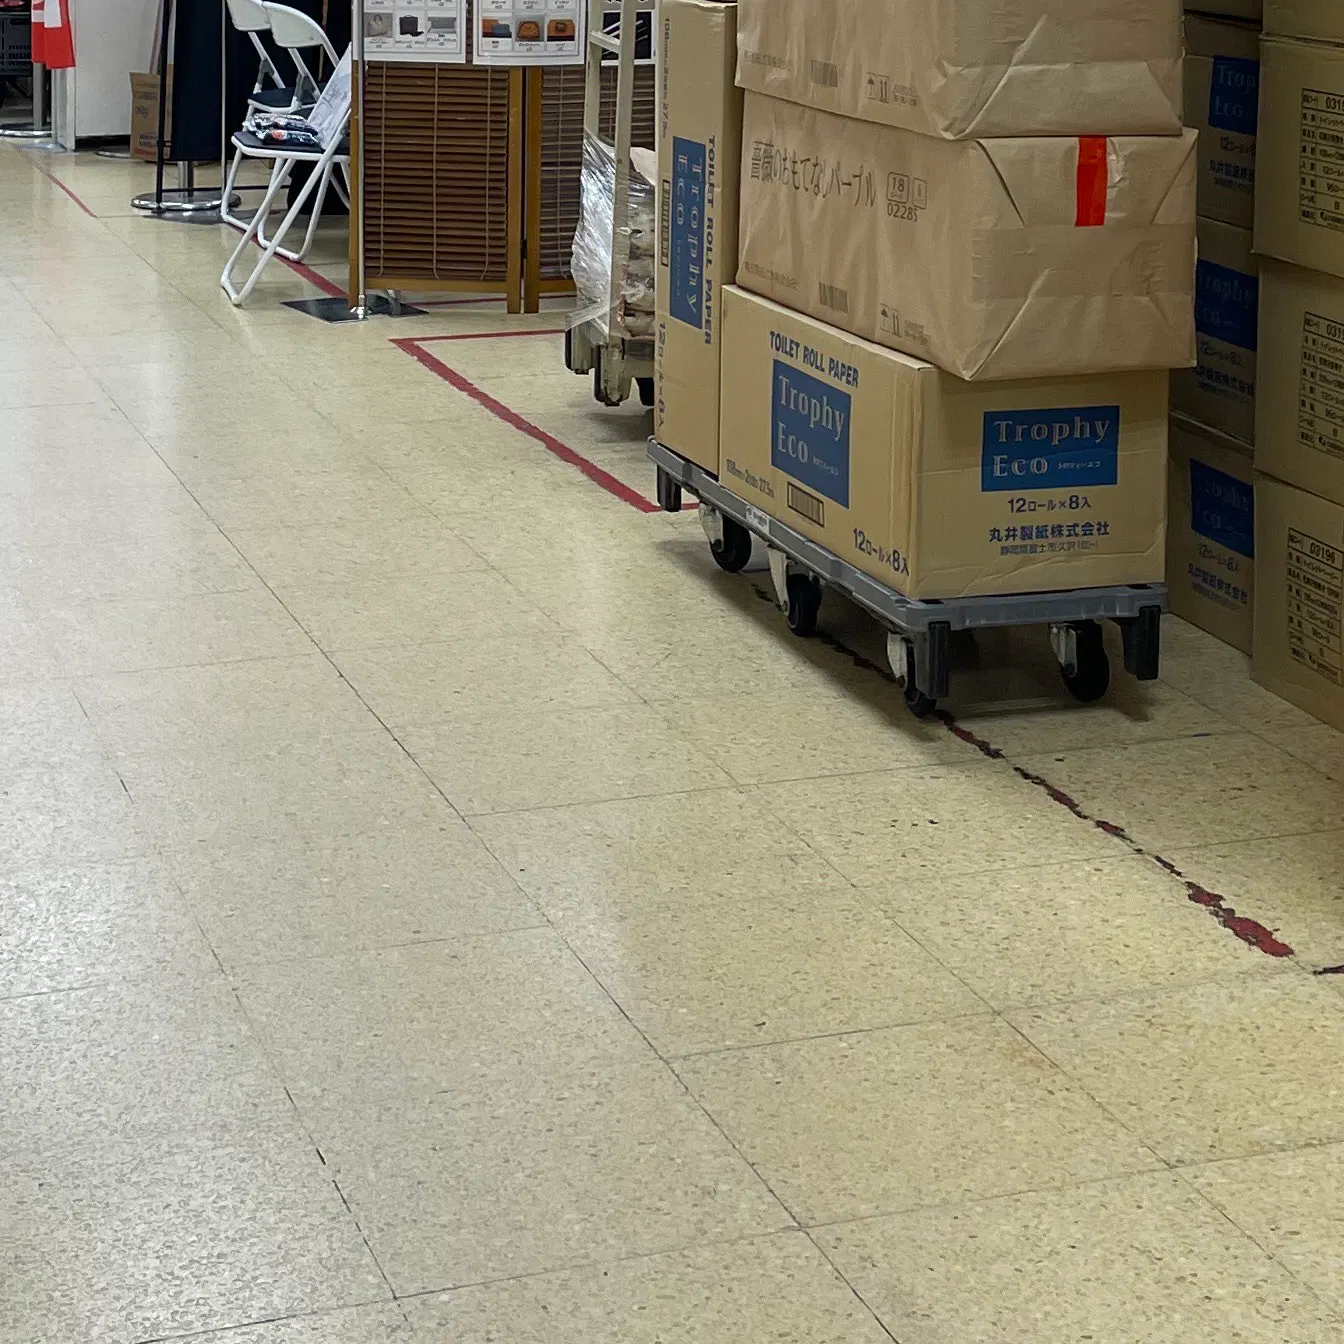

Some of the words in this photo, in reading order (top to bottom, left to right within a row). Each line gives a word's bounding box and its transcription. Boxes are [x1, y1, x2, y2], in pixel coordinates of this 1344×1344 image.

[676, 154, 689, 225] Eco
[708, 135, 718, 208] TOILET
[891, 176, 904, 191] 18
[706, 217, 716, 264] ROLL
[704, 274, 715, 344] PAPER
[770, 331, 800, 360] TOILET
[804, 346, 825, 371] ROLL
[829, 357, 859, 387] PAPER
[778, 376, 845, 440] Trophy
[778, 422, 809, 464] Eco
[994, 417, 1109, 446] Trophy
[993, 454, 1048, 478] Eco
[1008, 495, 1091, 515] 12ロール×8入
[989, 521, 1110, 543] 丸井製紙株式会社
[1310, 543, 1336, 564] 03196
